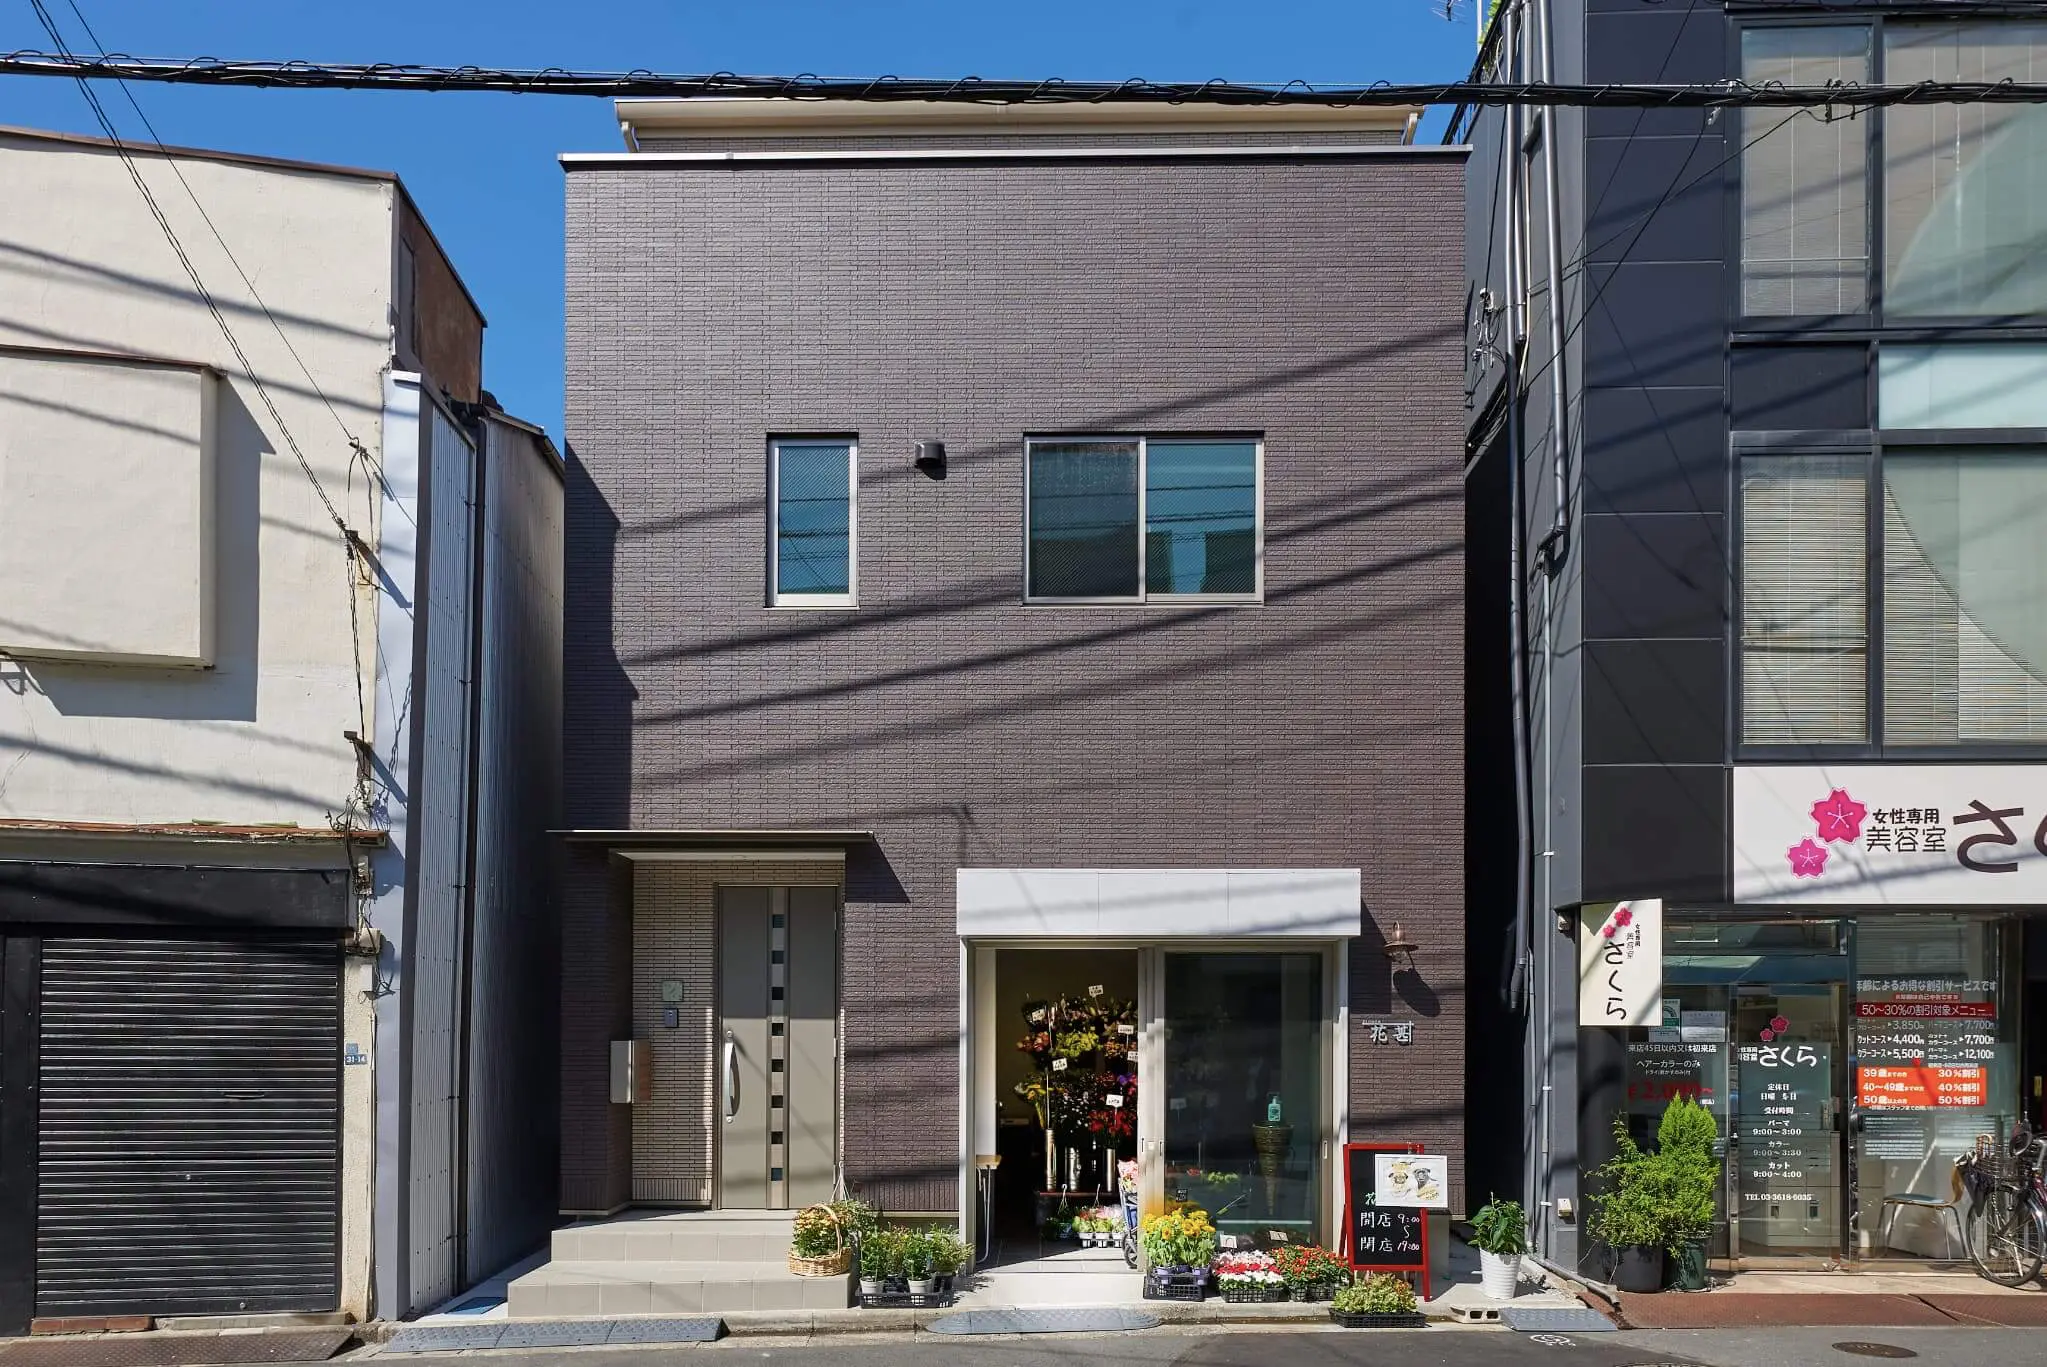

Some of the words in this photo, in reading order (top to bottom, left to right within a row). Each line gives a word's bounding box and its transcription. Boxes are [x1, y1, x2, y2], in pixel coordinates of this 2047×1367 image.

[1873, 808, 1940, 825] 女性専用
[1866, 826, 1947, 853] 美容室
[1953, 799, 2047, 873] さ
[1604, 941, 1627, 1020] さくら
[1758, 1045, 1817, 1068] さくら
[1360, 1211, 1391, 1228] 開店
